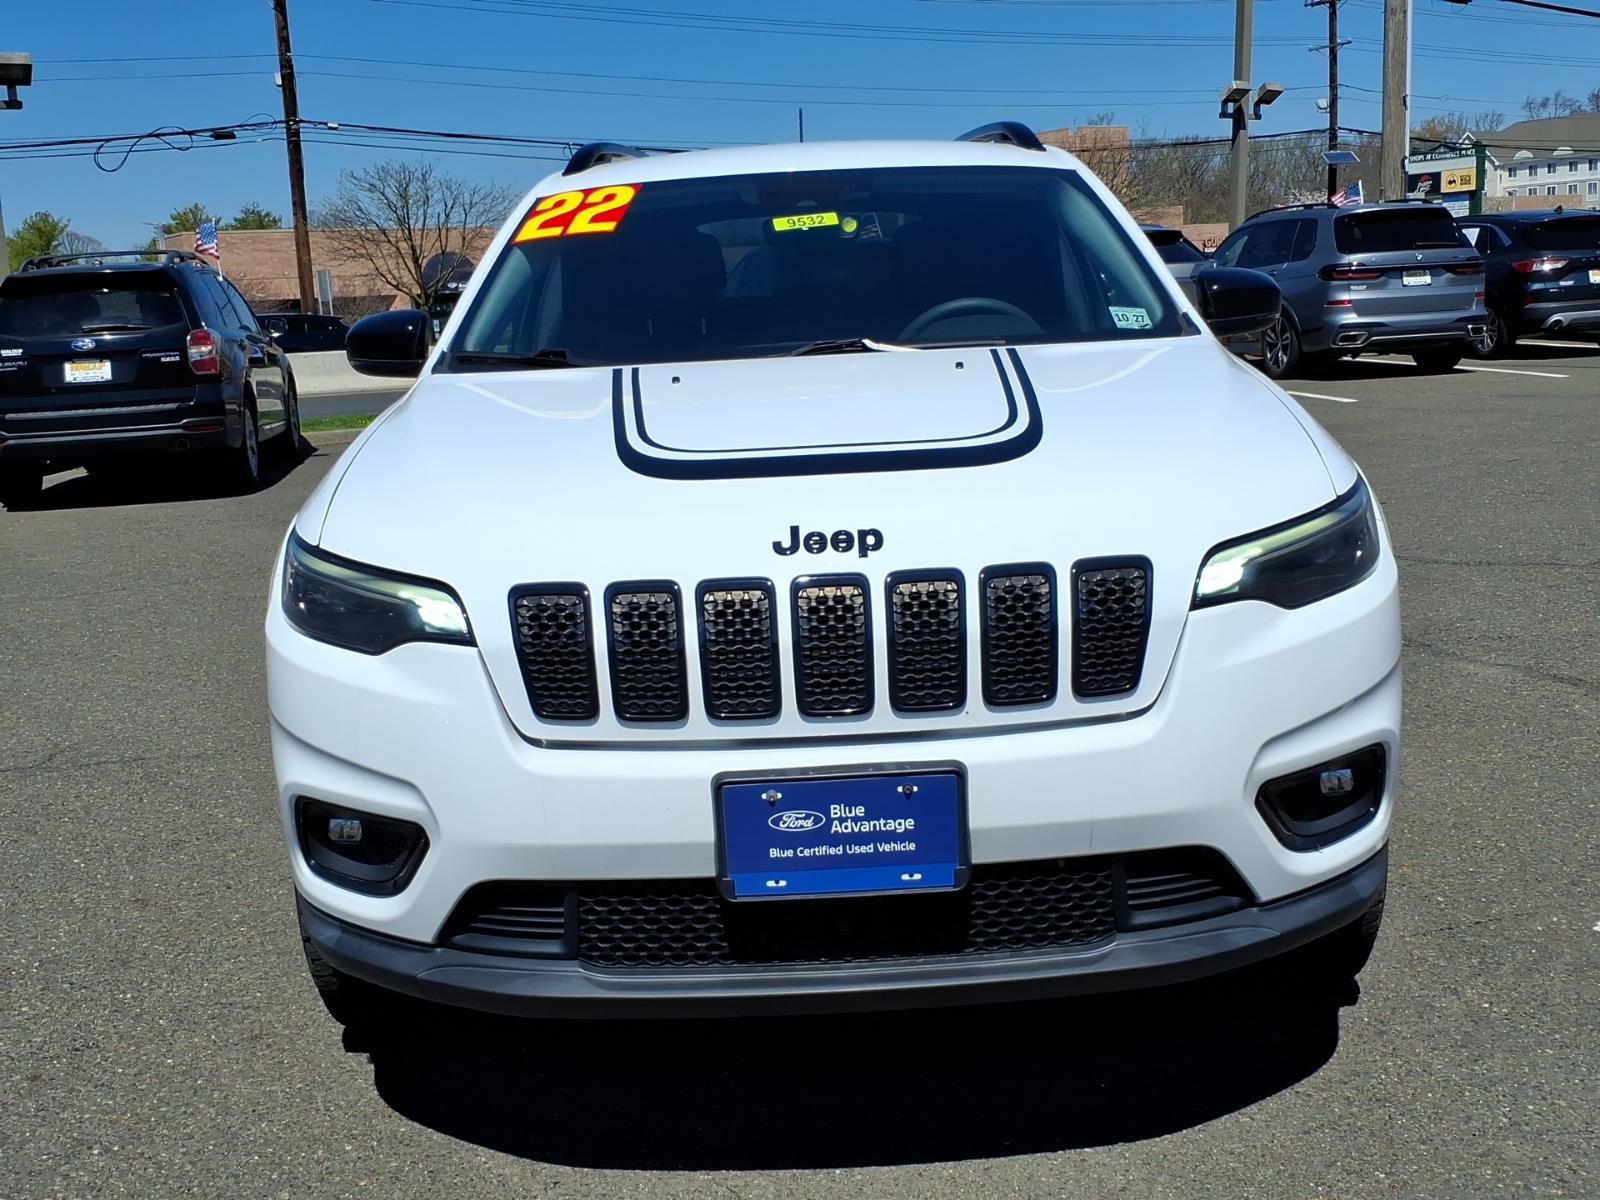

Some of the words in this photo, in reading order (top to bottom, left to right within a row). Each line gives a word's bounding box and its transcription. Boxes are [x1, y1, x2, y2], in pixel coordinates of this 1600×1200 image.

[514, 185, 636, 243] 22
[786, 214, 827, 229] 9532
[1115, 313, 1130, 322] 10
[1132, 314, 1145, 323] 27
[772, 525, 884, 558] Jeep
[830, 803, 865, 818] Blue
[779, 812, 815, 829] Ford
[830, 817, 915, 834] Advantage
[769, 847, 794, 858] Blue
[796, 845, 843, 857] Certified
[846, 842, 874, 855] Used
[877, 840, 916, 853] Vehicle
